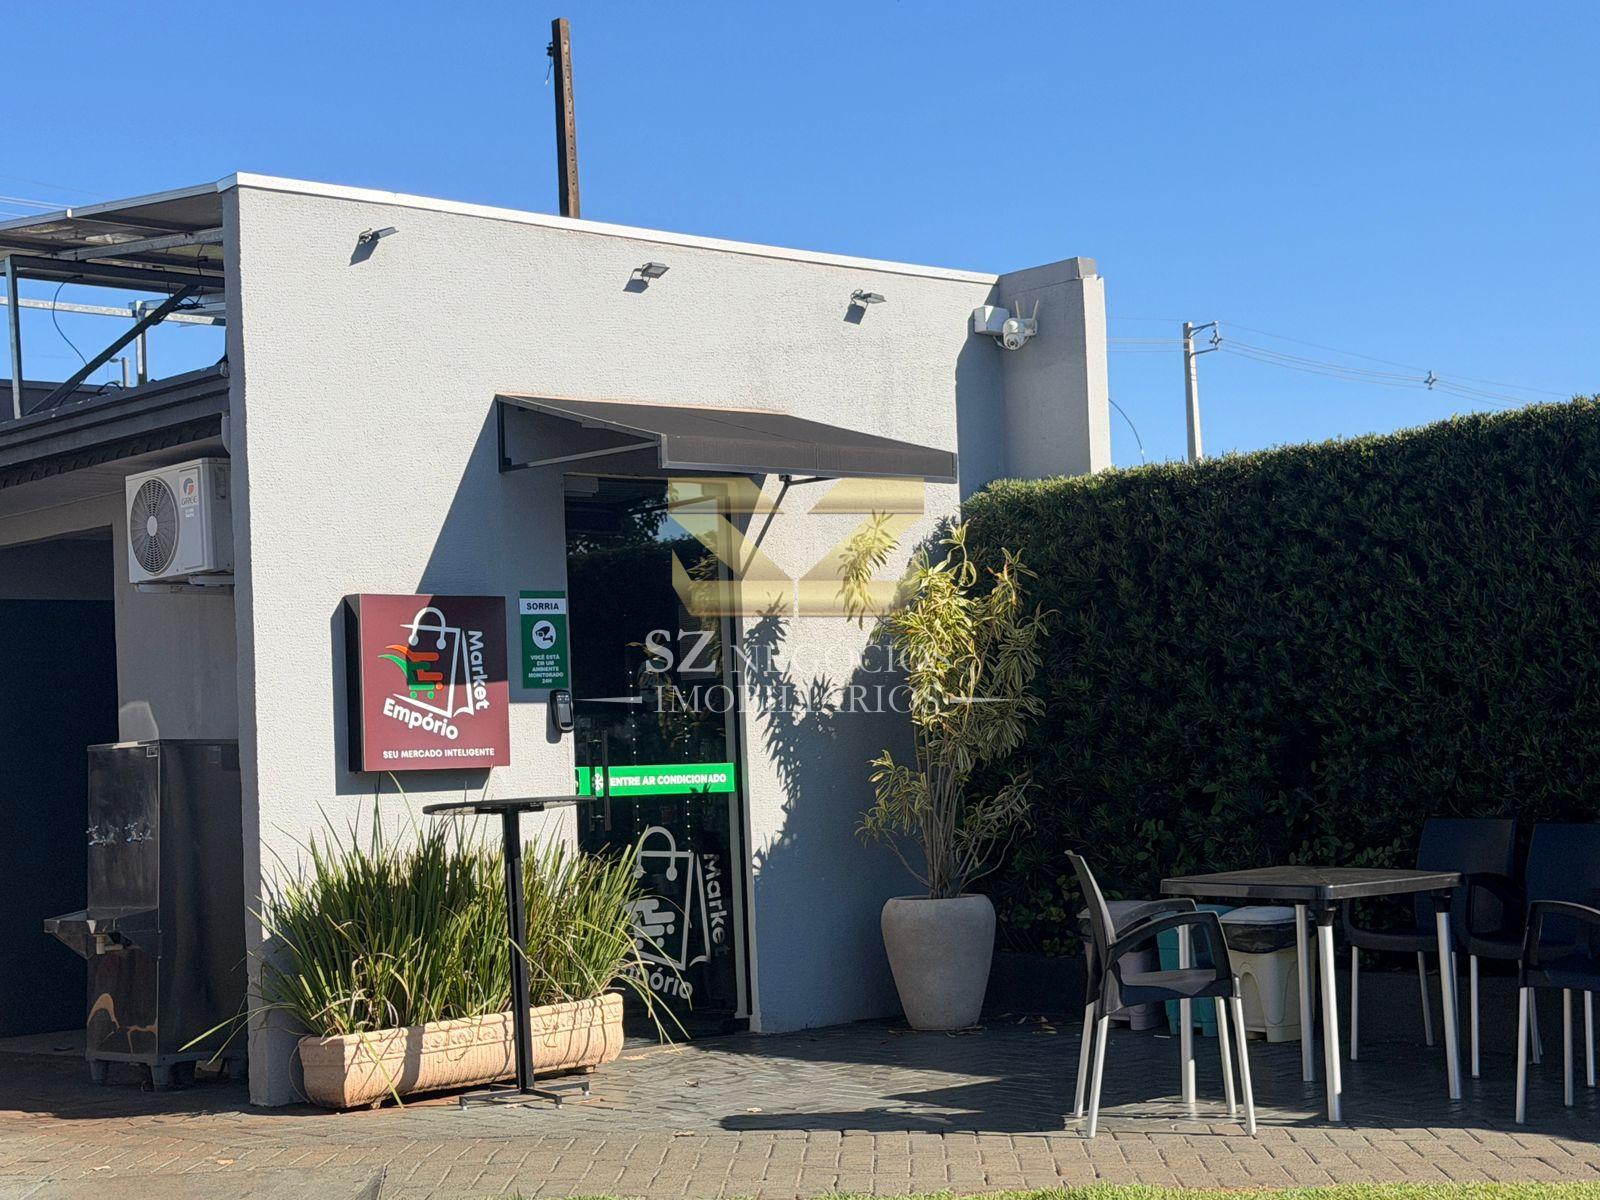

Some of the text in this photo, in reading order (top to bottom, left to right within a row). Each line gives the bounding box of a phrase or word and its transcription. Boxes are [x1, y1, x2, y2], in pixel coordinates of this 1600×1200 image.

[526, 602, 560, 611] SORRIA
[467, 630, 490, 711] Market
[382, 697, 459, 740] Empório
[382, 747, 496, 760] SEU MERCADO INTELIGENTE
[609, 773, 727, 787] ENTRE AR CONDICIONADO
[623, 966, 694, 1000] mpório
